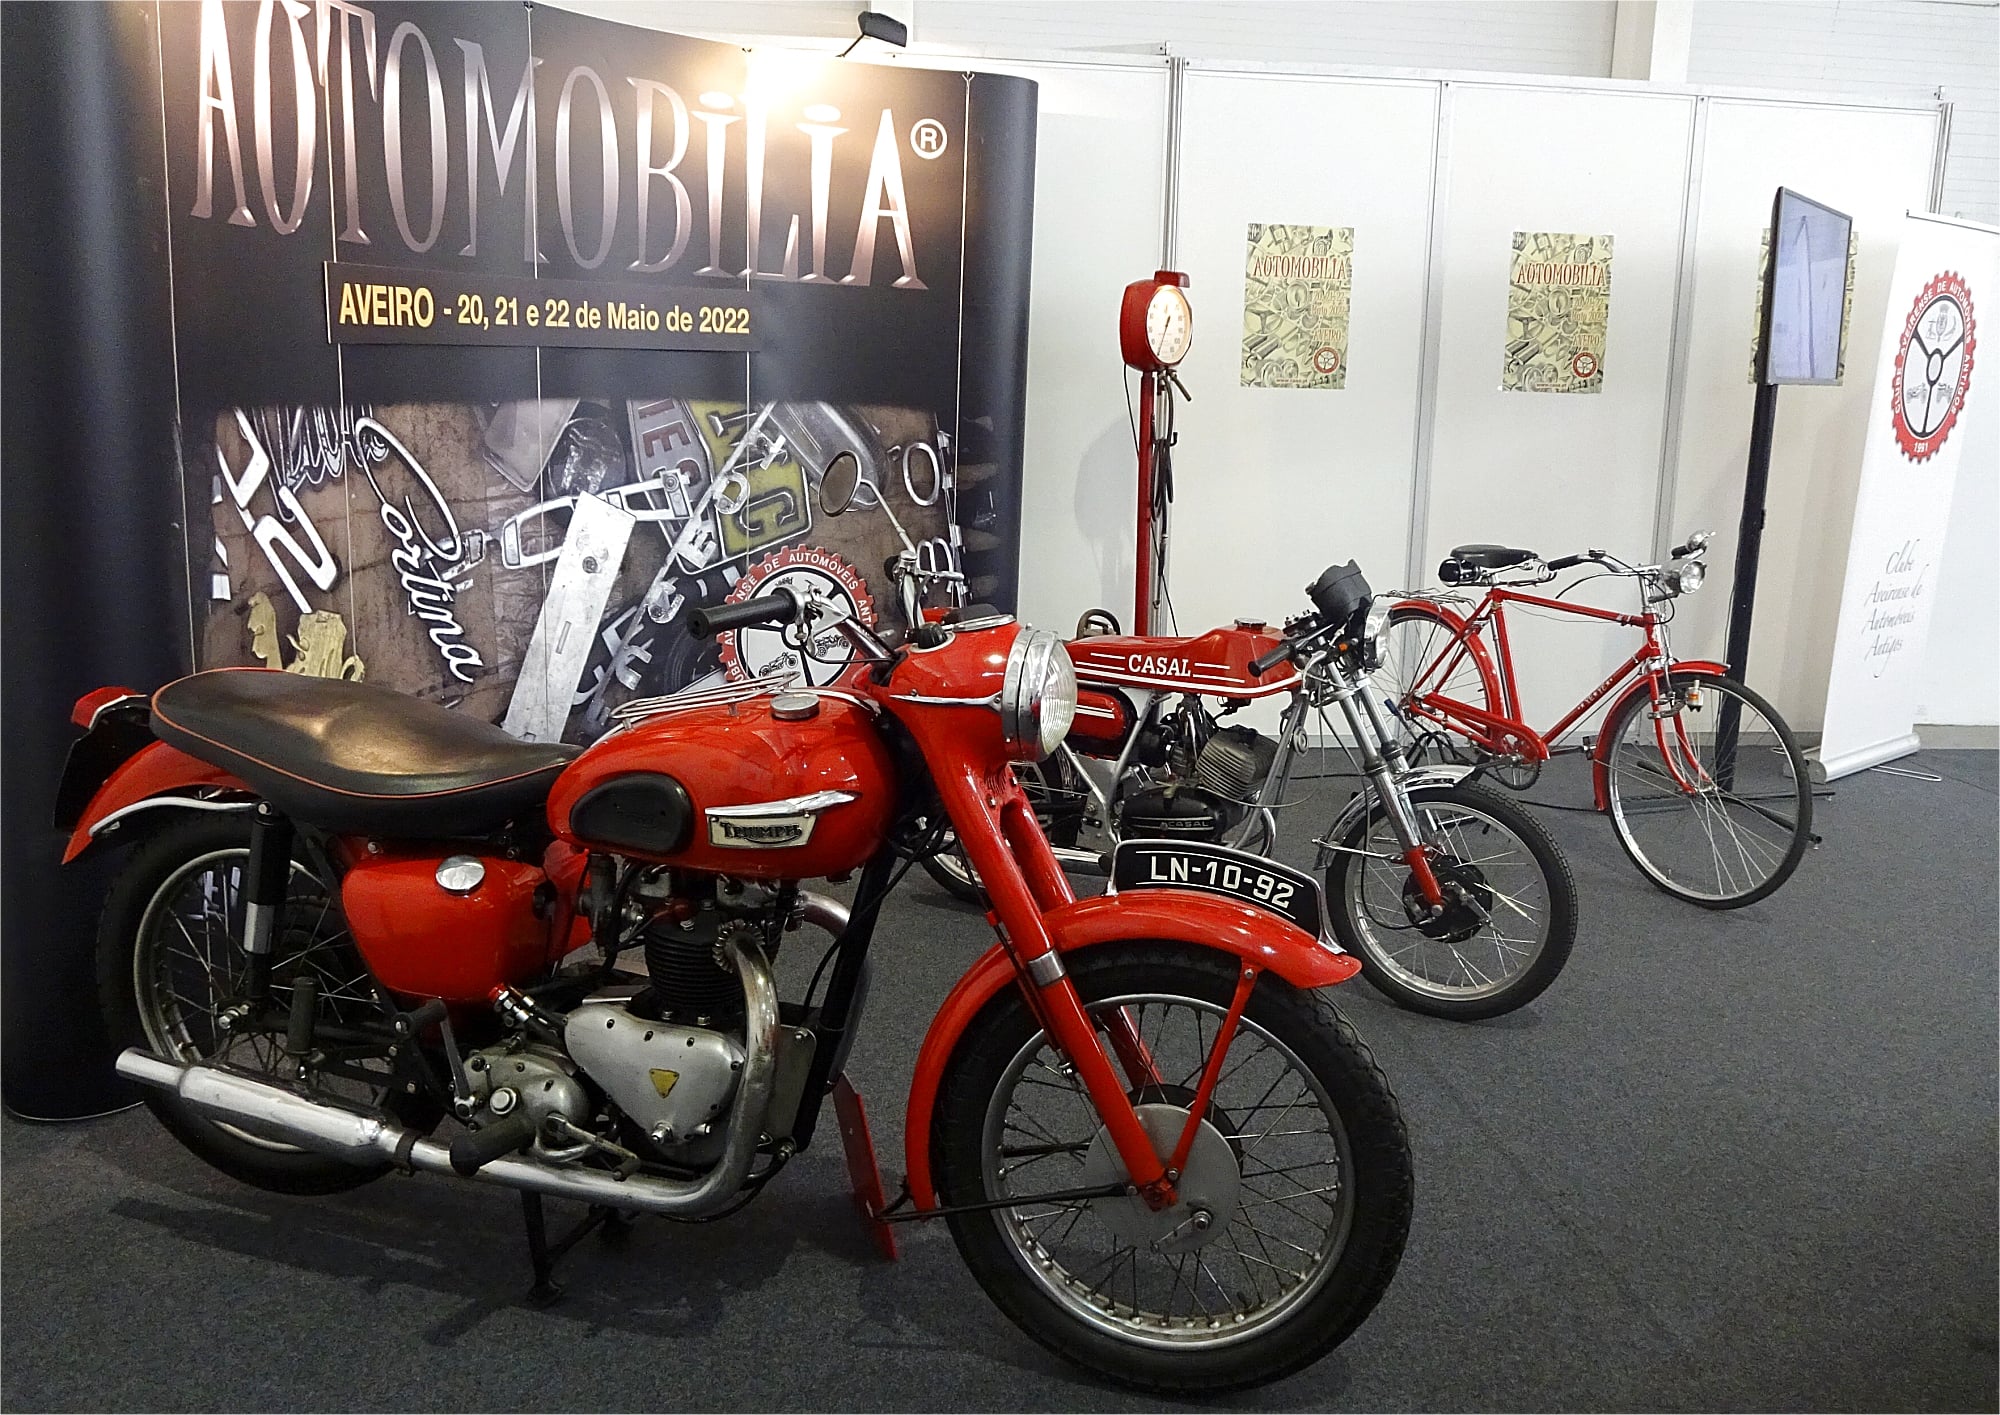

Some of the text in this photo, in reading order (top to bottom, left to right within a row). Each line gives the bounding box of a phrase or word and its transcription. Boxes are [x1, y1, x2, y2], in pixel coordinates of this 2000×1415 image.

[1253, 255, 1347, 279] AUTOMOBILIA
[1516, 263, 1606, 286] AUTOMOBILIA
[1937, 281, 1947, 292] DE
[339, 282, 435, 328] AVEIRO
[457, 294, 490, 331] 20,
[495, 296, 518, 326] 21
[526, 304, 540, 327] e
[545, 298, 570, 328] 22
[575, 301, 601, 329] de
[607, 302, 660, 331] Maio
[666, 305, 693, 332] de
[699, 306, 750, 334] 2022
[764, 557, 781, 574] DE
[789, 552, 859, 590] AUTOMÓVEIS
[1128, 653, 1192, 677] CASAL
[1150, 856, 1295, 909] LN-10-92
